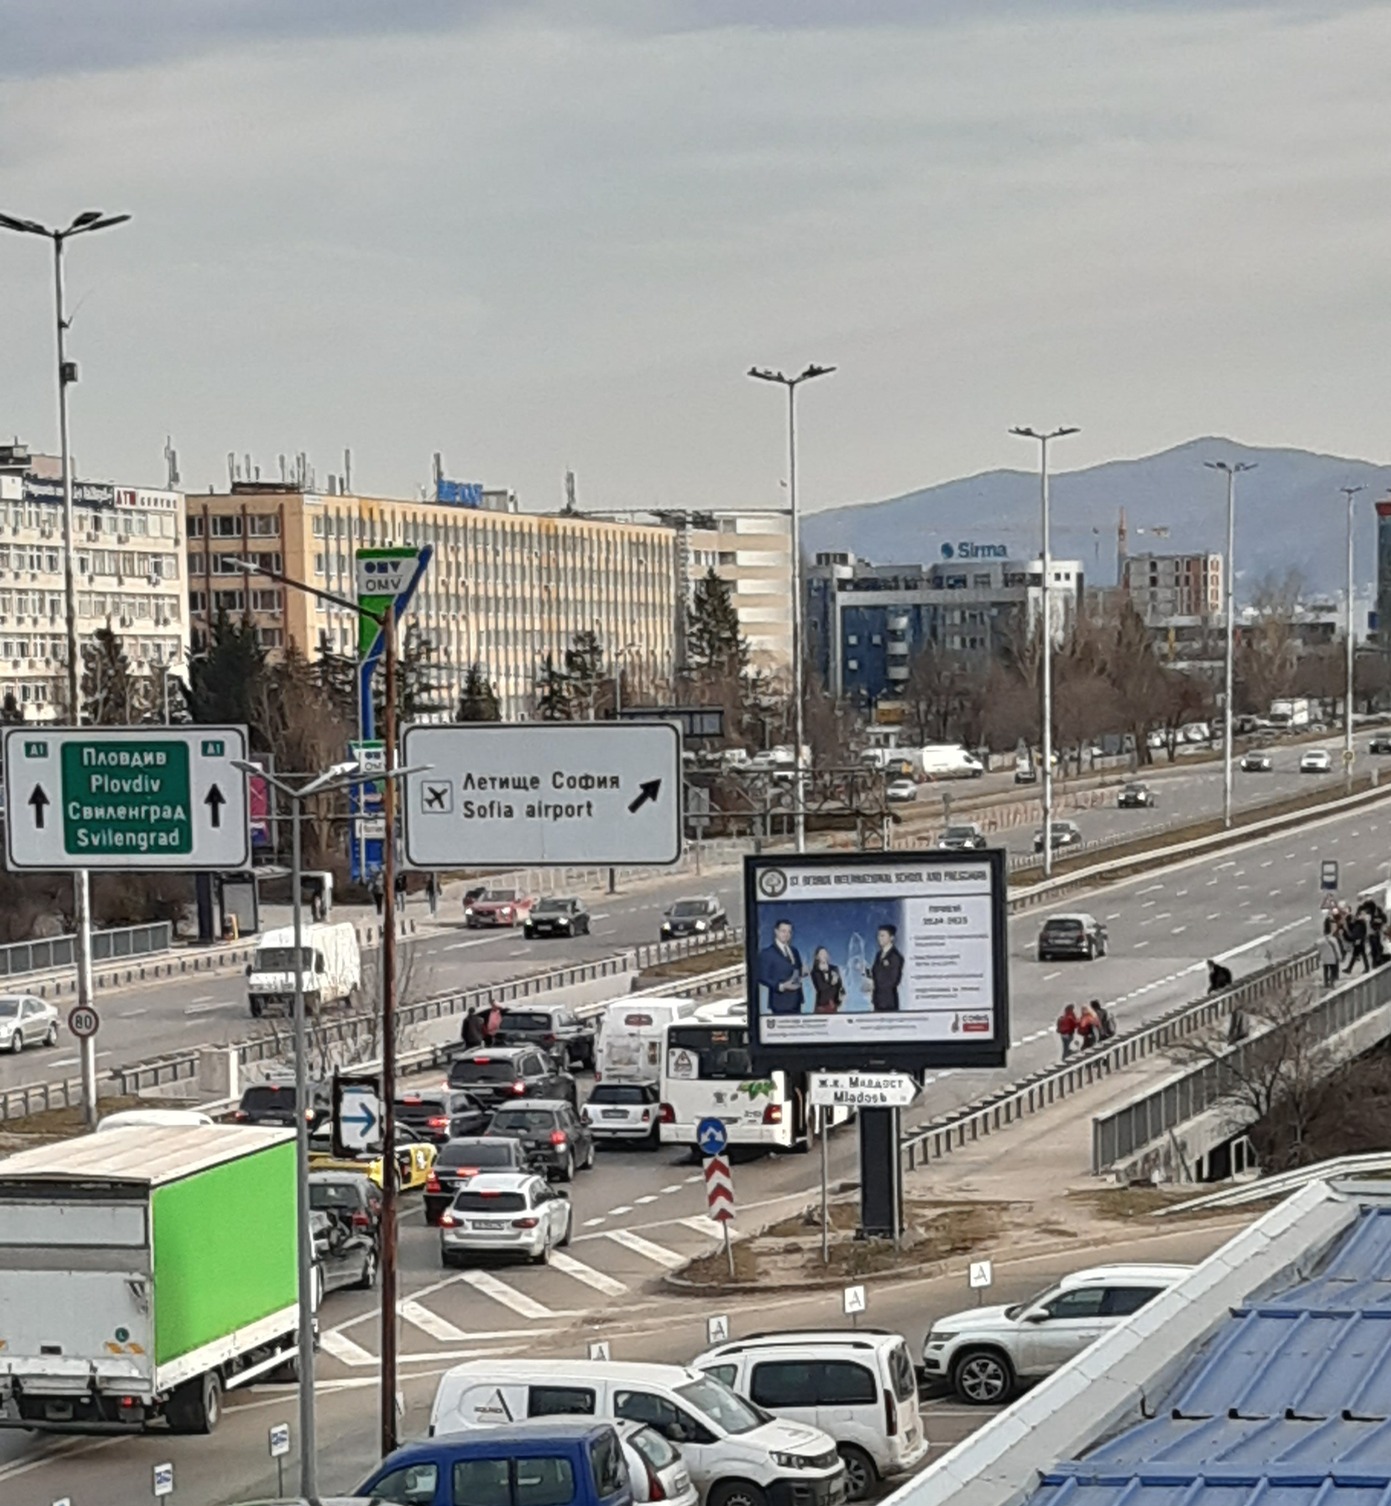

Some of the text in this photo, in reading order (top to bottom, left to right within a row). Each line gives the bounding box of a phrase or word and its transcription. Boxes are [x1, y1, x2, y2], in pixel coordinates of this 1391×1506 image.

[958, 542, 1007, 558] Sirma
[366, 578, 401, 592] OMV
[30, 743, 44, 755] A1
[83, 748, 167, 768] Пловдив
[206, 743, 221, 754] A1
[91, 774, 161, 793] Plovdiv
[463, 771, 620, 791] Летище София
[68, 802, 186, 823] Свиленград
[463, 800, 593, 821] Sofia airport
[77, 829, 180, 850] Svilengrad
[75, 1015, 92, 1029] 80
